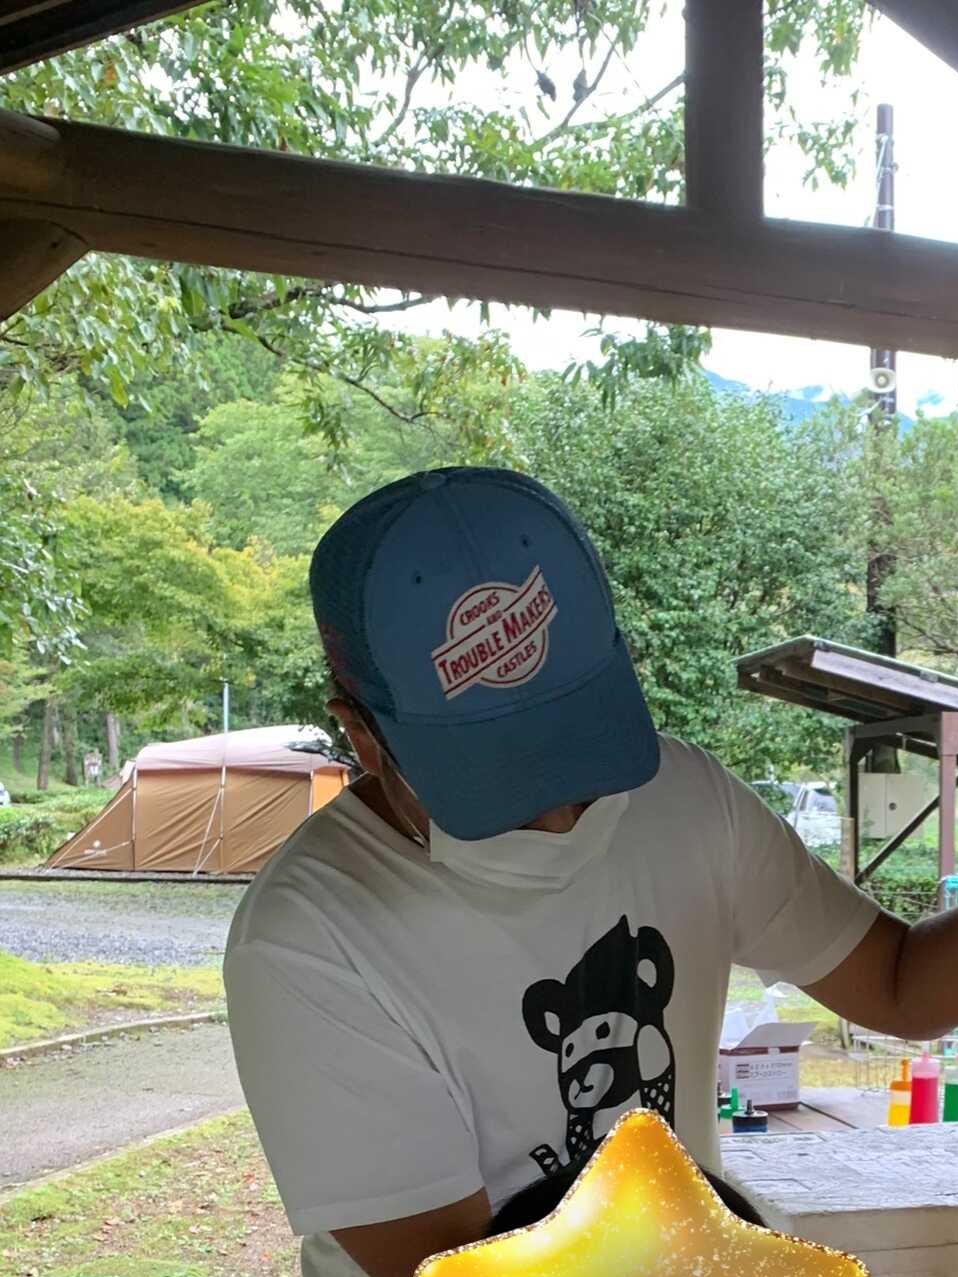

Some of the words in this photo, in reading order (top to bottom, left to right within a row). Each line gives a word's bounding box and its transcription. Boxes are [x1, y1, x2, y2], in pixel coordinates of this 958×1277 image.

[460, 592, 500, 626] CROOKS
[439, 631, 505, 684] TROUBLE
[502, 584, 551, 643] MAKERS
[497, 641, 537, 678] CASTLES
